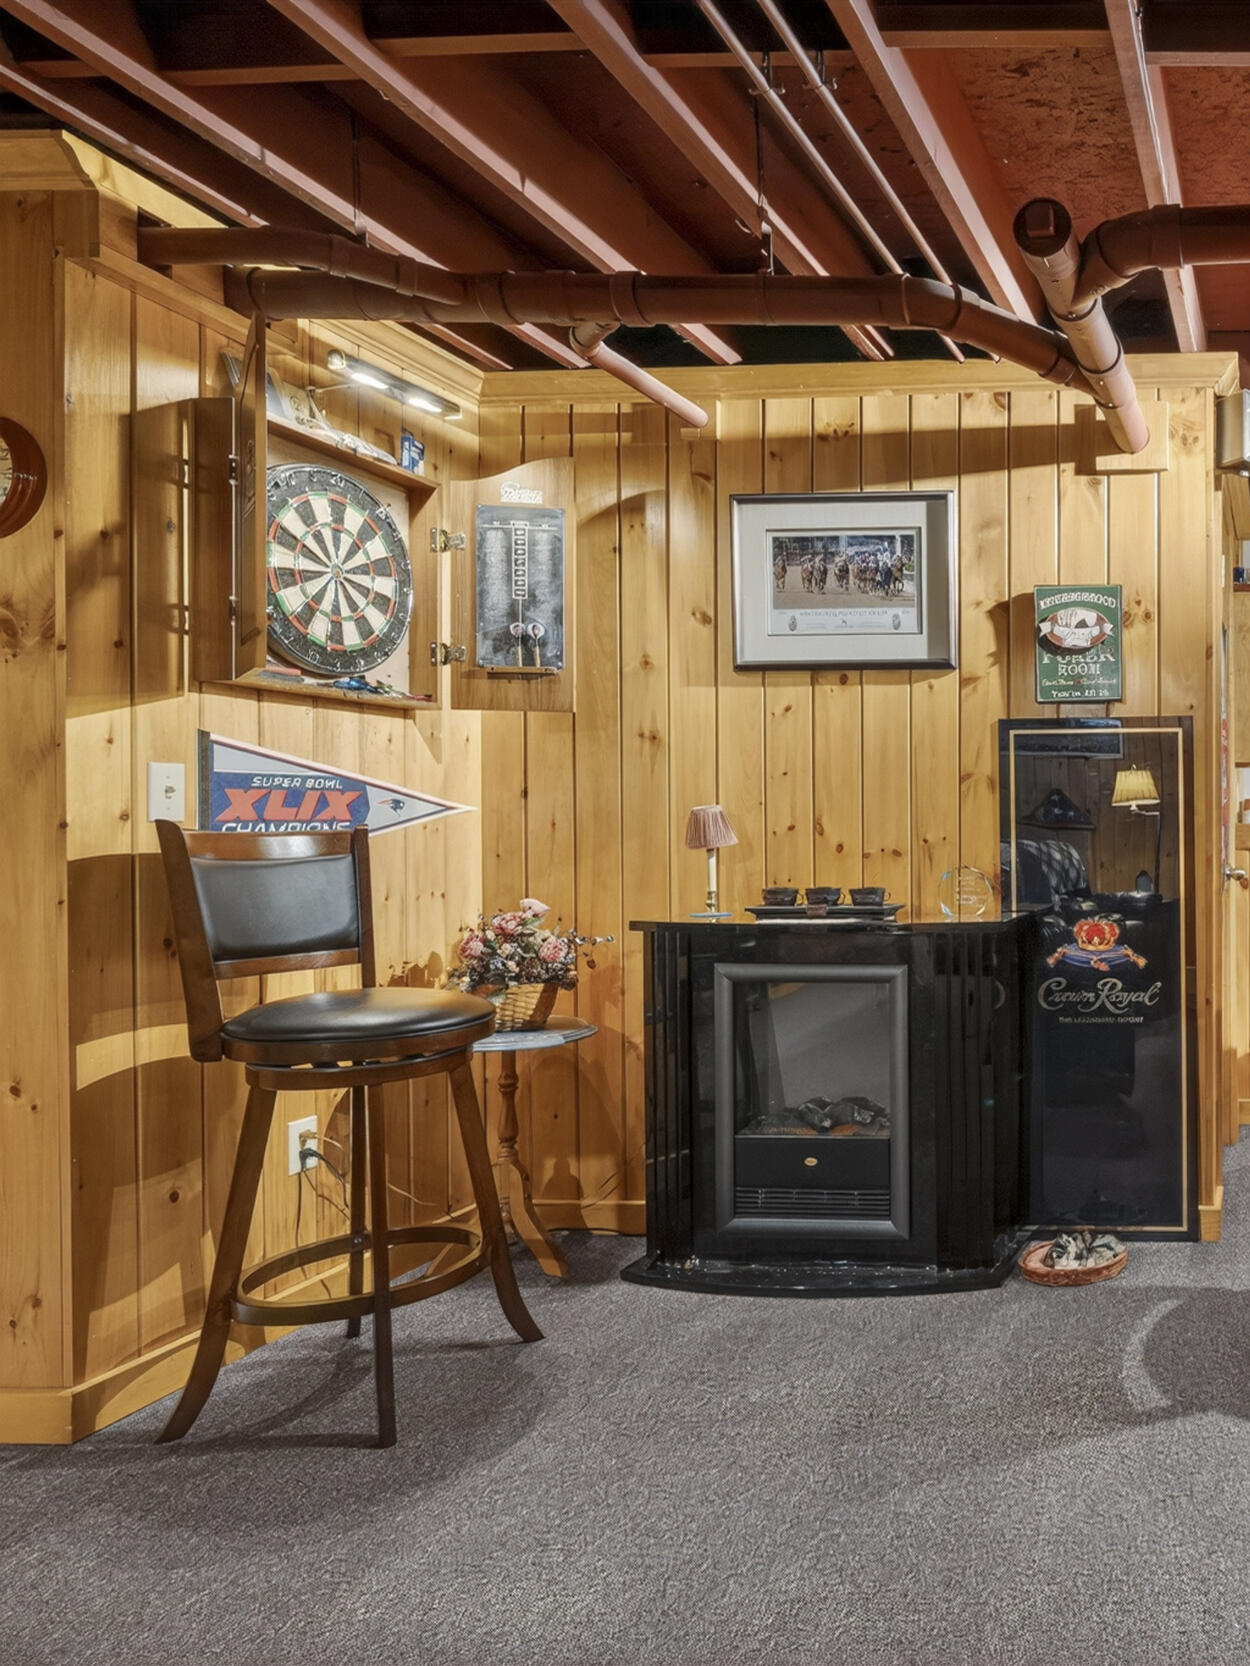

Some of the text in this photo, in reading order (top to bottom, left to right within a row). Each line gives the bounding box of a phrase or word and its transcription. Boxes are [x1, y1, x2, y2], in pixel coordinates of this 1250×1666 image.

[251, 776, 343, 789] SUPER BOWL
[215, 788, 362, 821] XLIX
[1038, 977, 1162, 1014] Crown Royal
